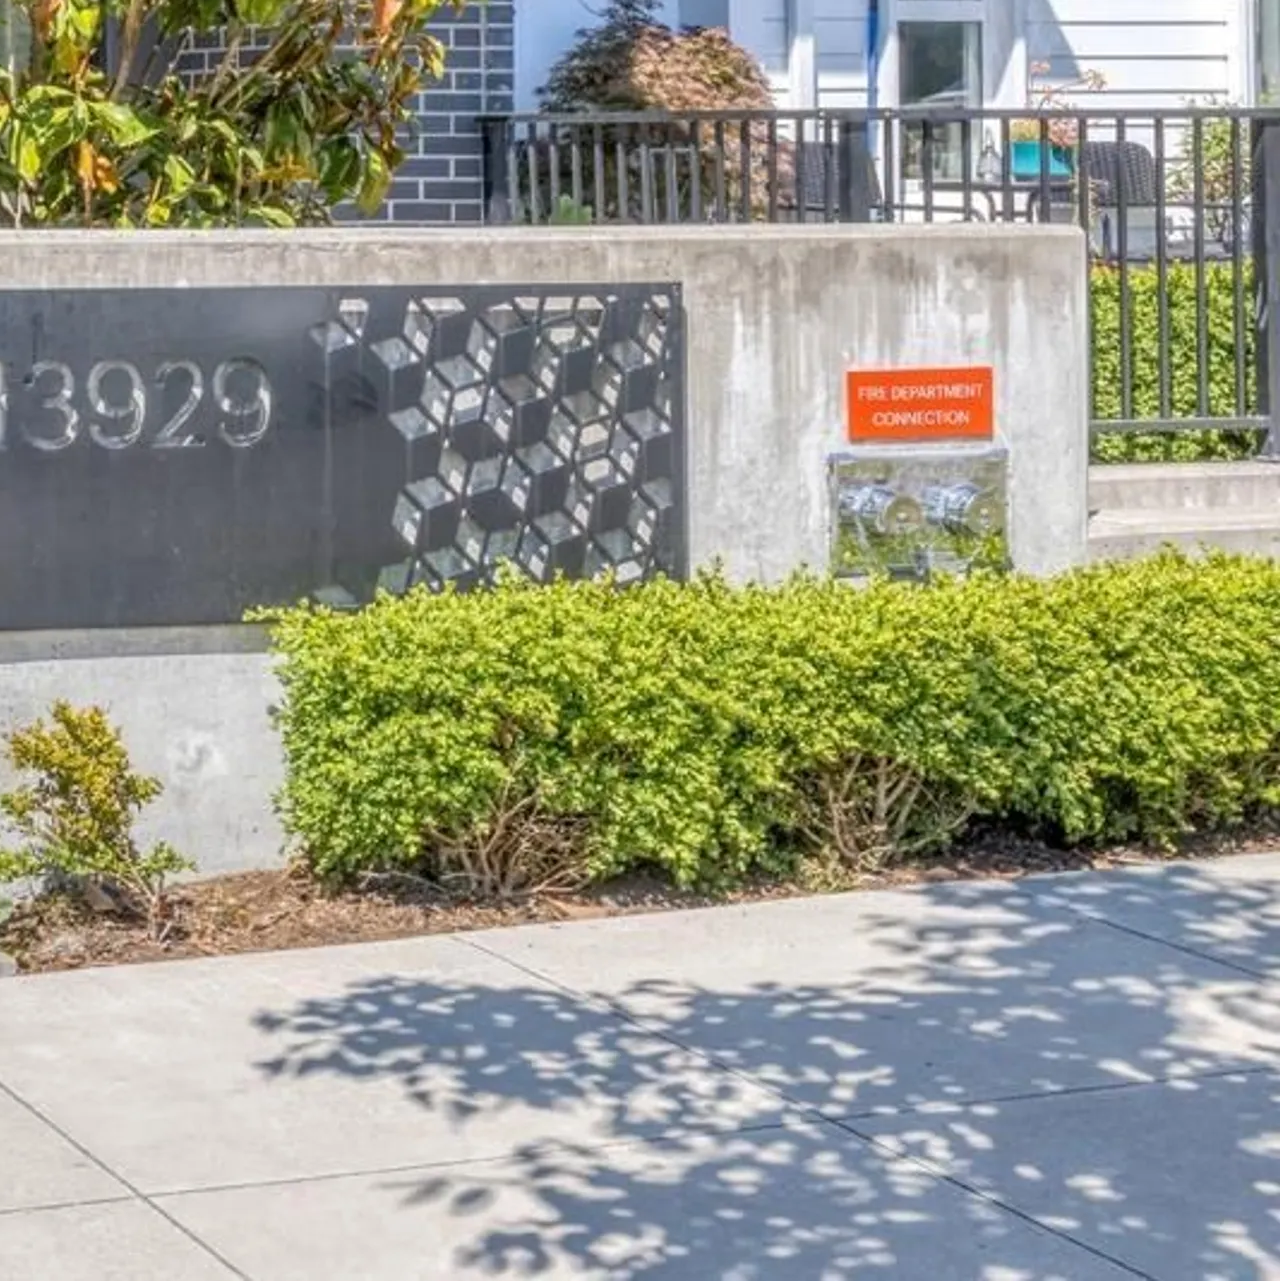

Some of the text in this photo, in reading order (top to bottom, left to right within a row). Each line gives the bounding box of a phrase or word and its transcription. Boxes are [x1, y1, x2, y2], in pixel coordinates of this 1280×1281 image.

[857, 382, 984, 402] FIRE DEPARTMENT
[871, 409, 970, 427] CONNECTION
